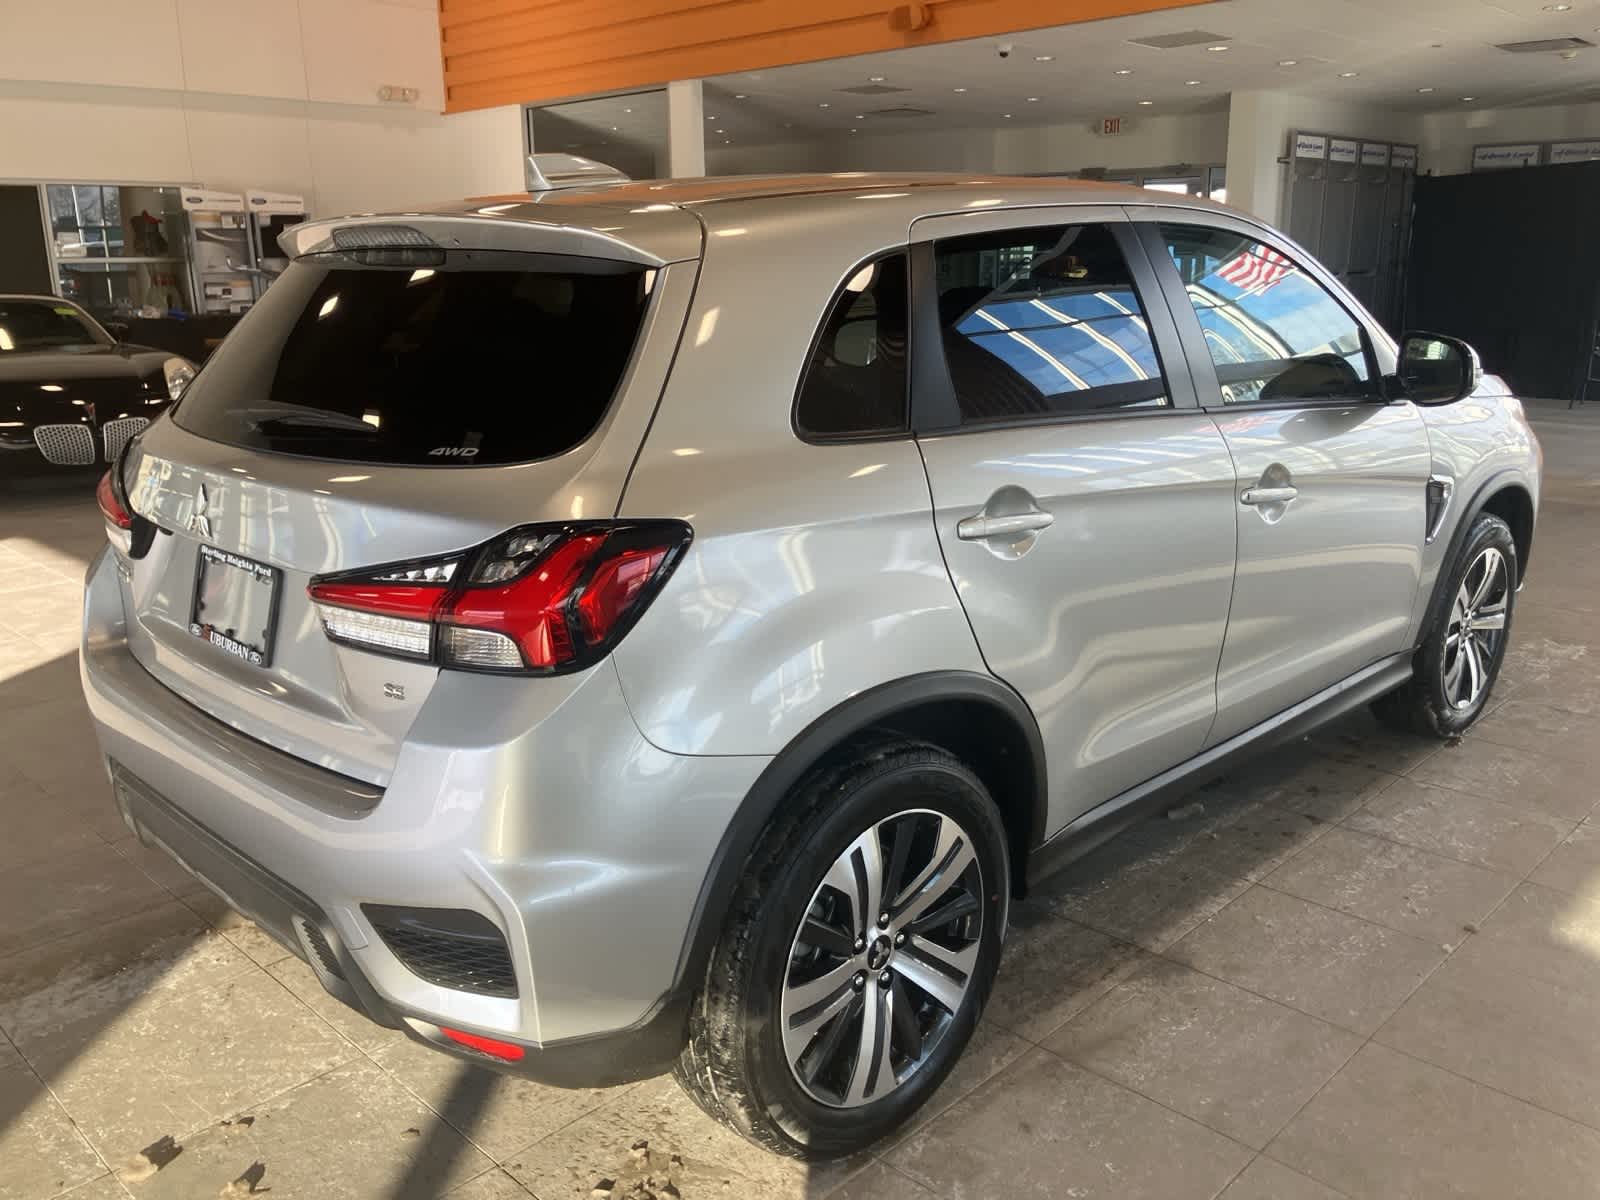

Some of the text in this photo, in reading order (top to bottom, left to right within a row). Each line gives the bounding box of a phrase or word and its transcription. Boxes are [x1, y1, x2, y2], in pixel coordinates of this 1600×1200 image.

[1104, 119, 1120, 134] EXIT
[428, 447, 479, 457] 4WD
[201, 624, 249, 660] SUBURBAN
